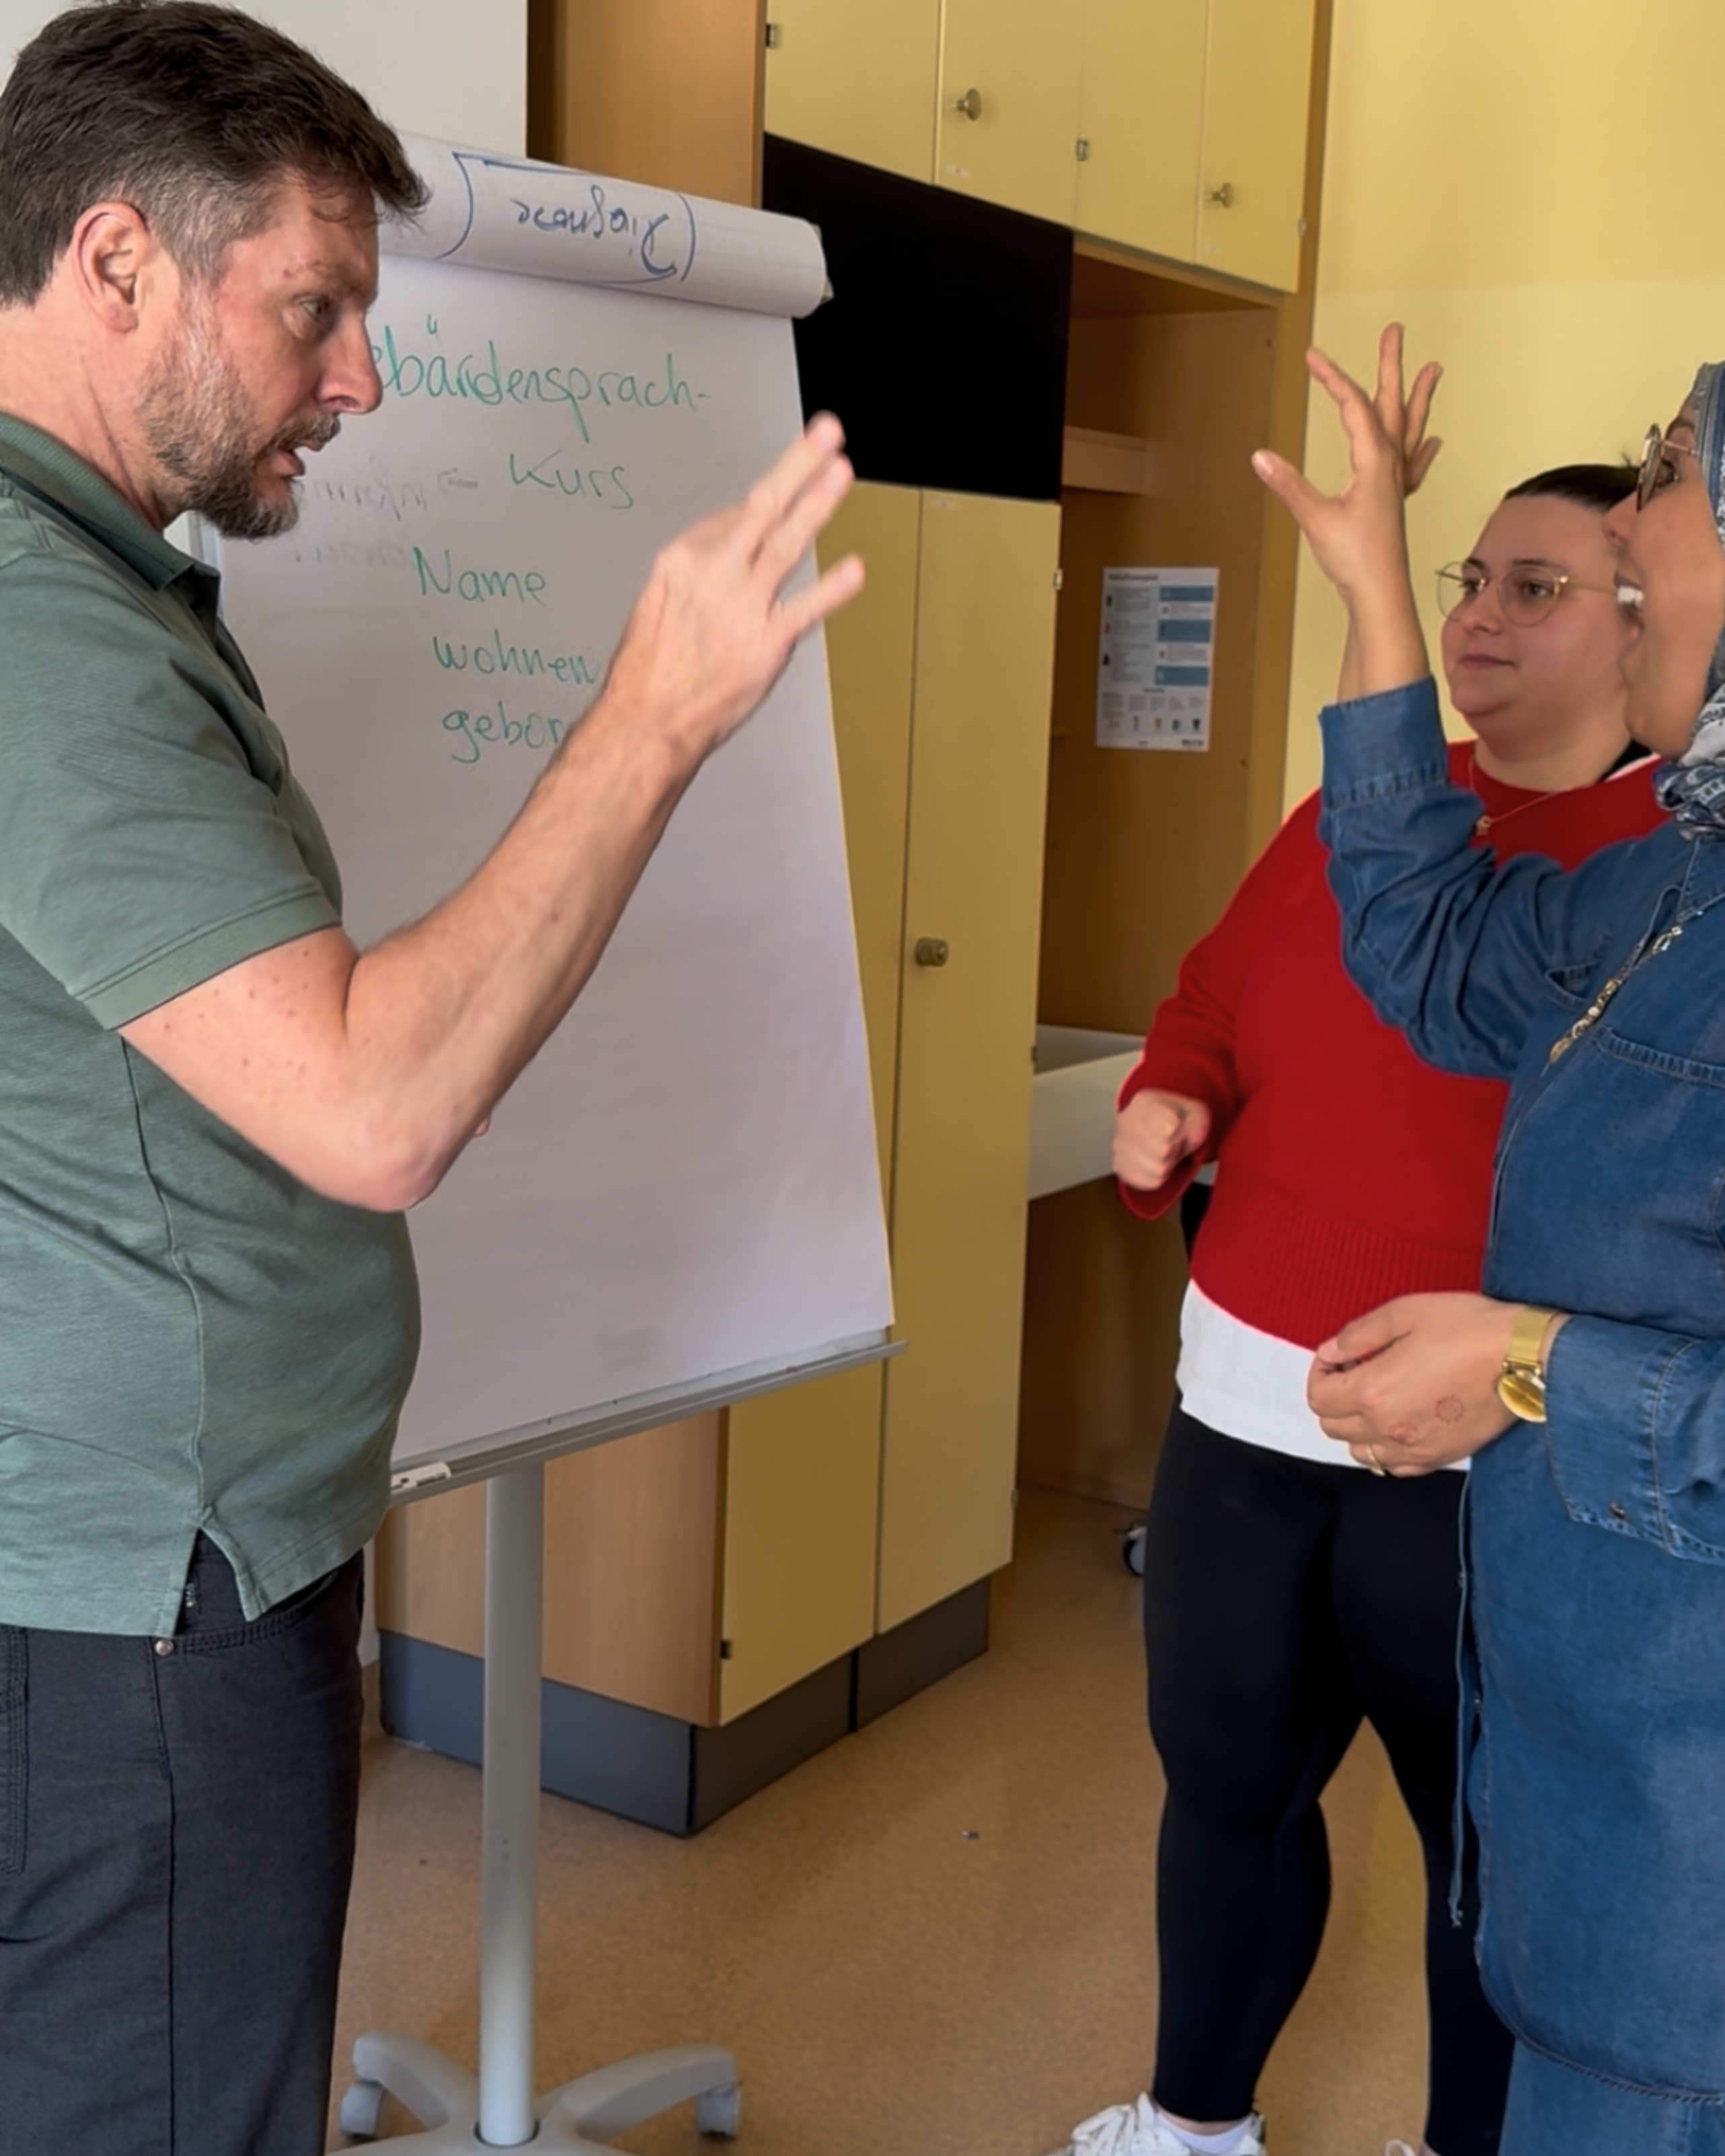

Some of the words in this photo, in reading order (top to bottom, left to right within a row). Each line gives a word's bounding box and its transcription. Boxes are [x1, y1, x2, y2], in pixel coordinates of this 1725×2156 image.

[509, 449, 634, 510] Kurs
[413, 546, 545, 607] Name
[432, 629, 600, 685] wohnen
